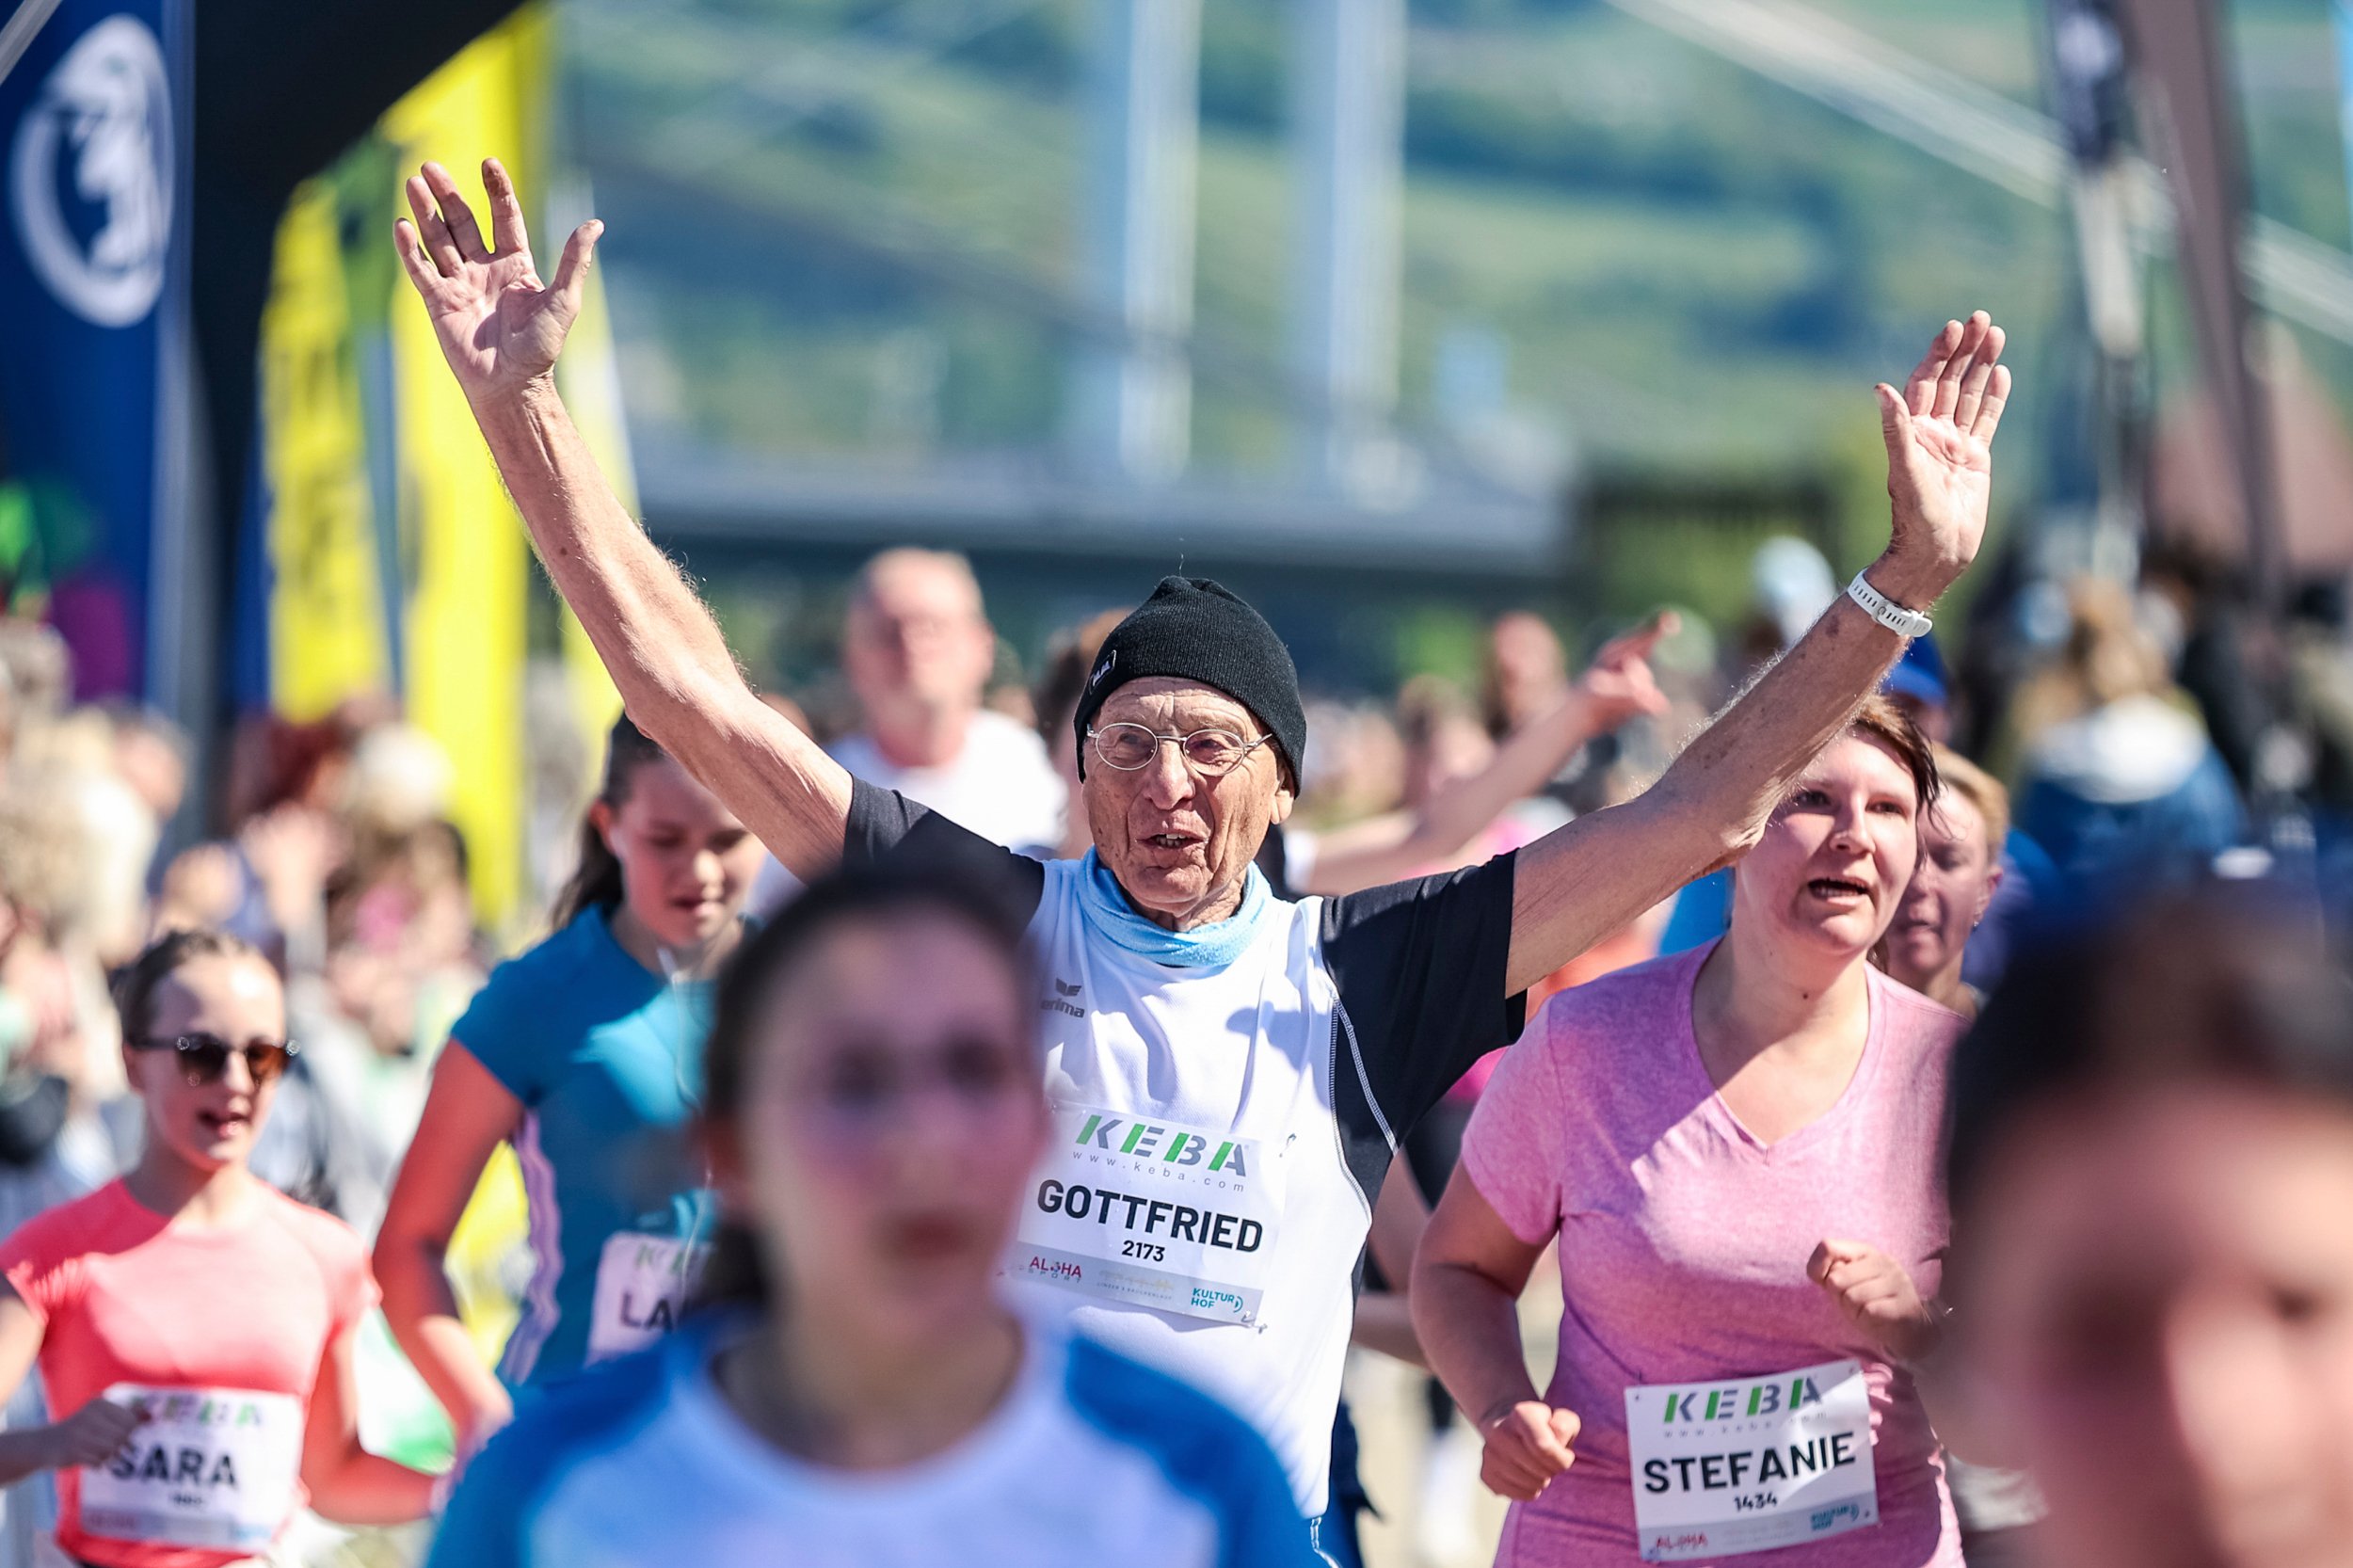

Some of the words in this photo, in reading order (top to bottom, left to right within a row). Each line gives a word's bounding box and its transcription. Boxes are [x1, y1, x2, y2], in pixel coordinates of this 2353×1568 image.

[1040, 999, 1085, 1018] erima
[1076, 1114, 1246, 1176] KEBA
[1072, 1150, 1244, 1192] www.keba.com
[1037, 1178, 1263, 1253] GOTTFRIED
[1122, 1240, 1165, 1262] 2173
[1191, 1297, 1215, 1309] HOF
[1192, 1288, 1235, 1304] KULTUR
[1663, 1376, 1822, 1424] KEBA
[110, 1443, 237, 1490] SARA
[1643, 1431, 1857, 1494] STEFANIE
[1734, 1491, 1778, 1512] 1434
